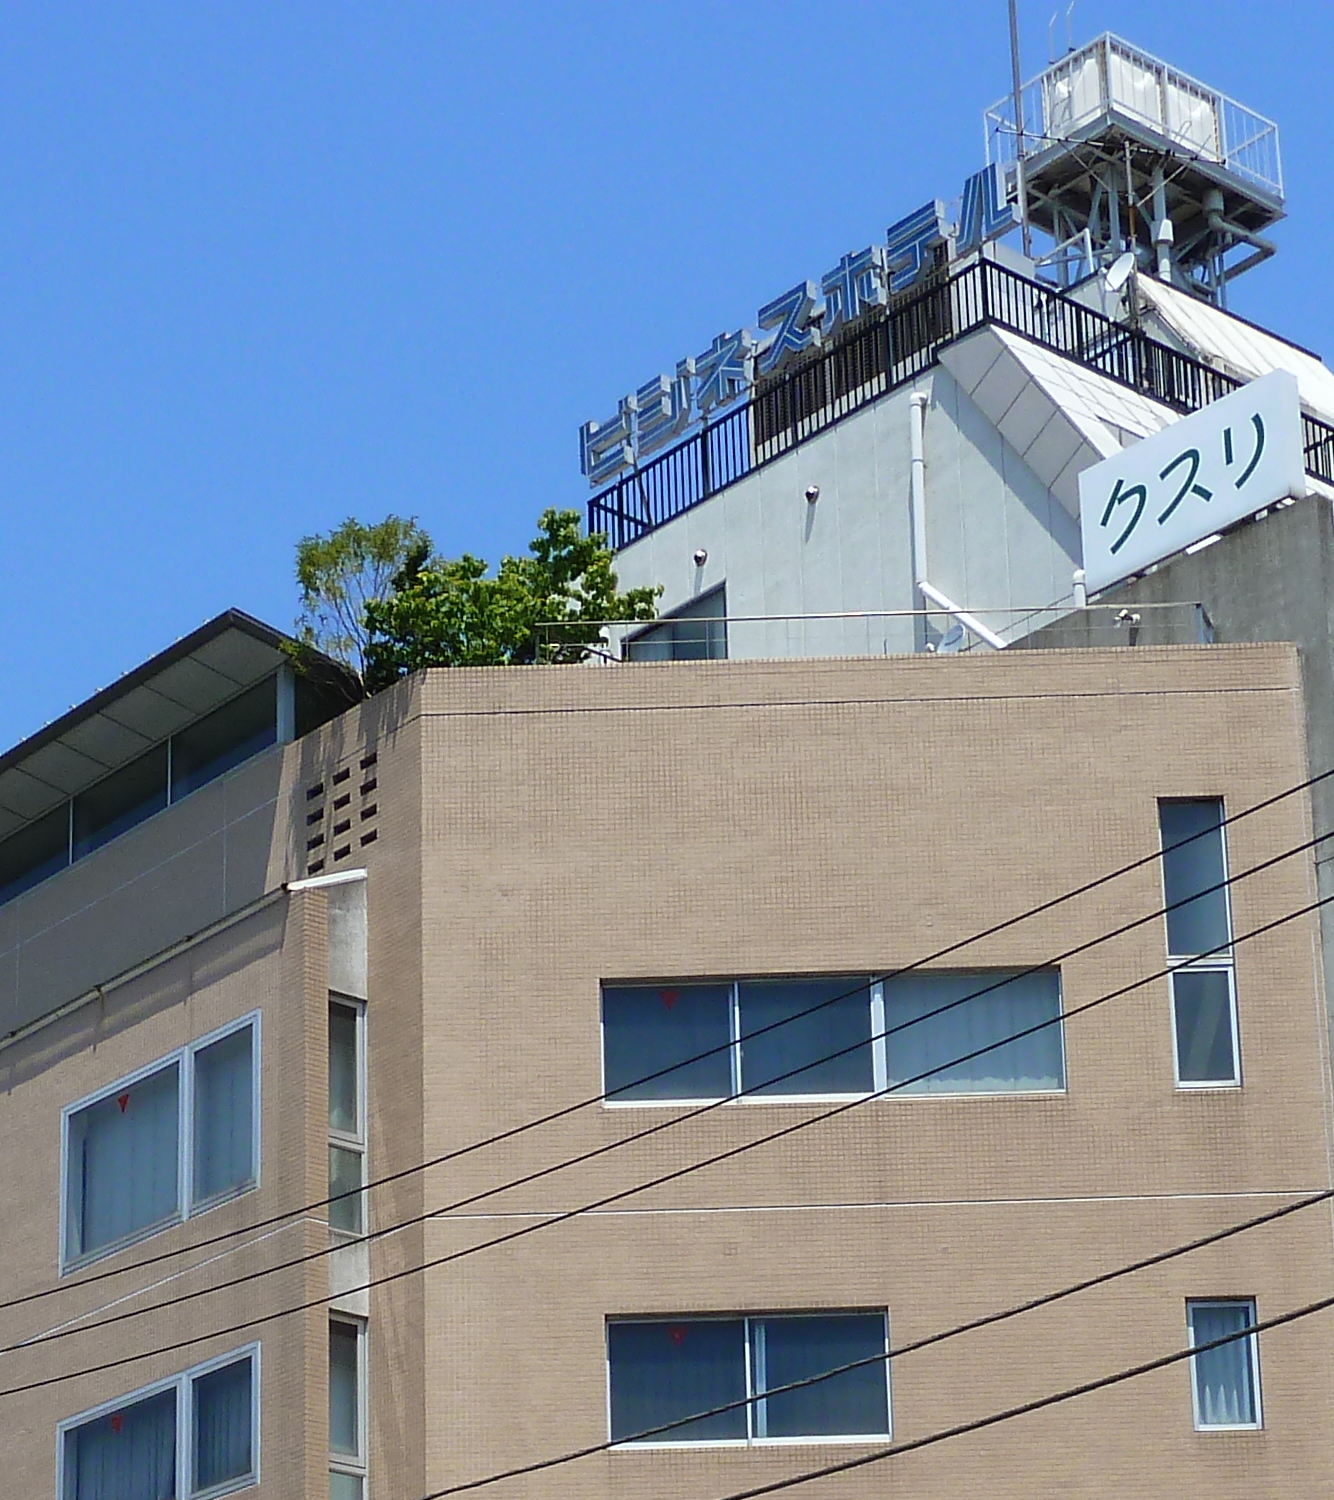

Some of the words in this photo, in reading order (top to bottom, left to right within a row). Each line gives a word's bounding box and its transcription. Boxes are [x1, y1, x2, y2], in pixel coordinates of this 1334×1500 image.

[579, 163, 1021, 487] ビジネスホテル
[1100, 412, 1267, 556] クスリ
